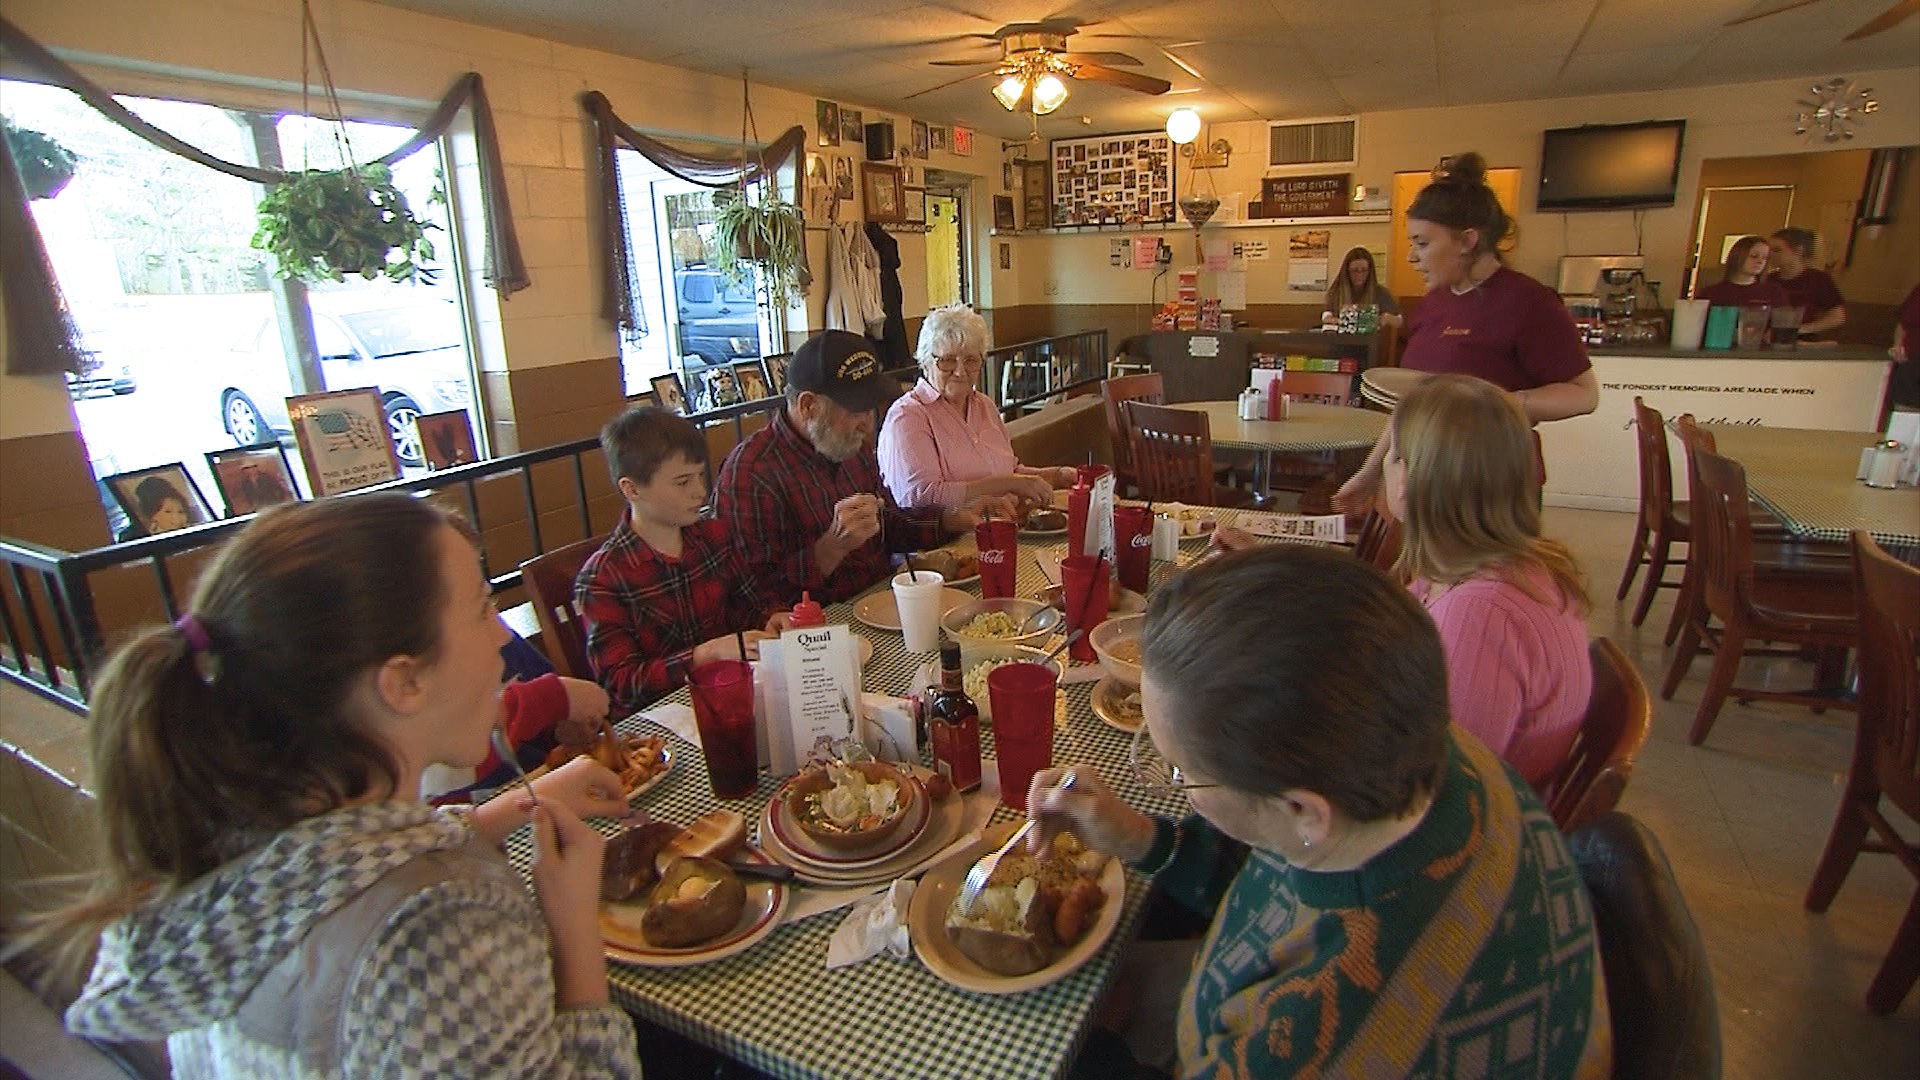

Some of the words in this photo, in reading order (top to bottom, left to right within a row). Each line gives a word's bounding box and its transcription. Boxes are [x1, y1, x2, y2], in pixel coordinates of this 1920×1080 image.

[1272, 183, 1286, 192] THE
[1288, 182, 1307, 191] LORD
[1309, 180, 1338, 190] GIVETH
[1274, 193, 1287, 202] THE
[1289, 190, 1336, 202] GOVERNMENT
[1602, 383, 1620, 391] THE
[1622, 383, 1666, 391] FONDEST
[1669, 384, 1720, 393] MEMORIES
[1781, 387, 1815, 395] WHEN
[352, 465, 368, 473] OUR
[340, 475, 367, 485] PROUD
[797, 631, 831, 647] Quail
